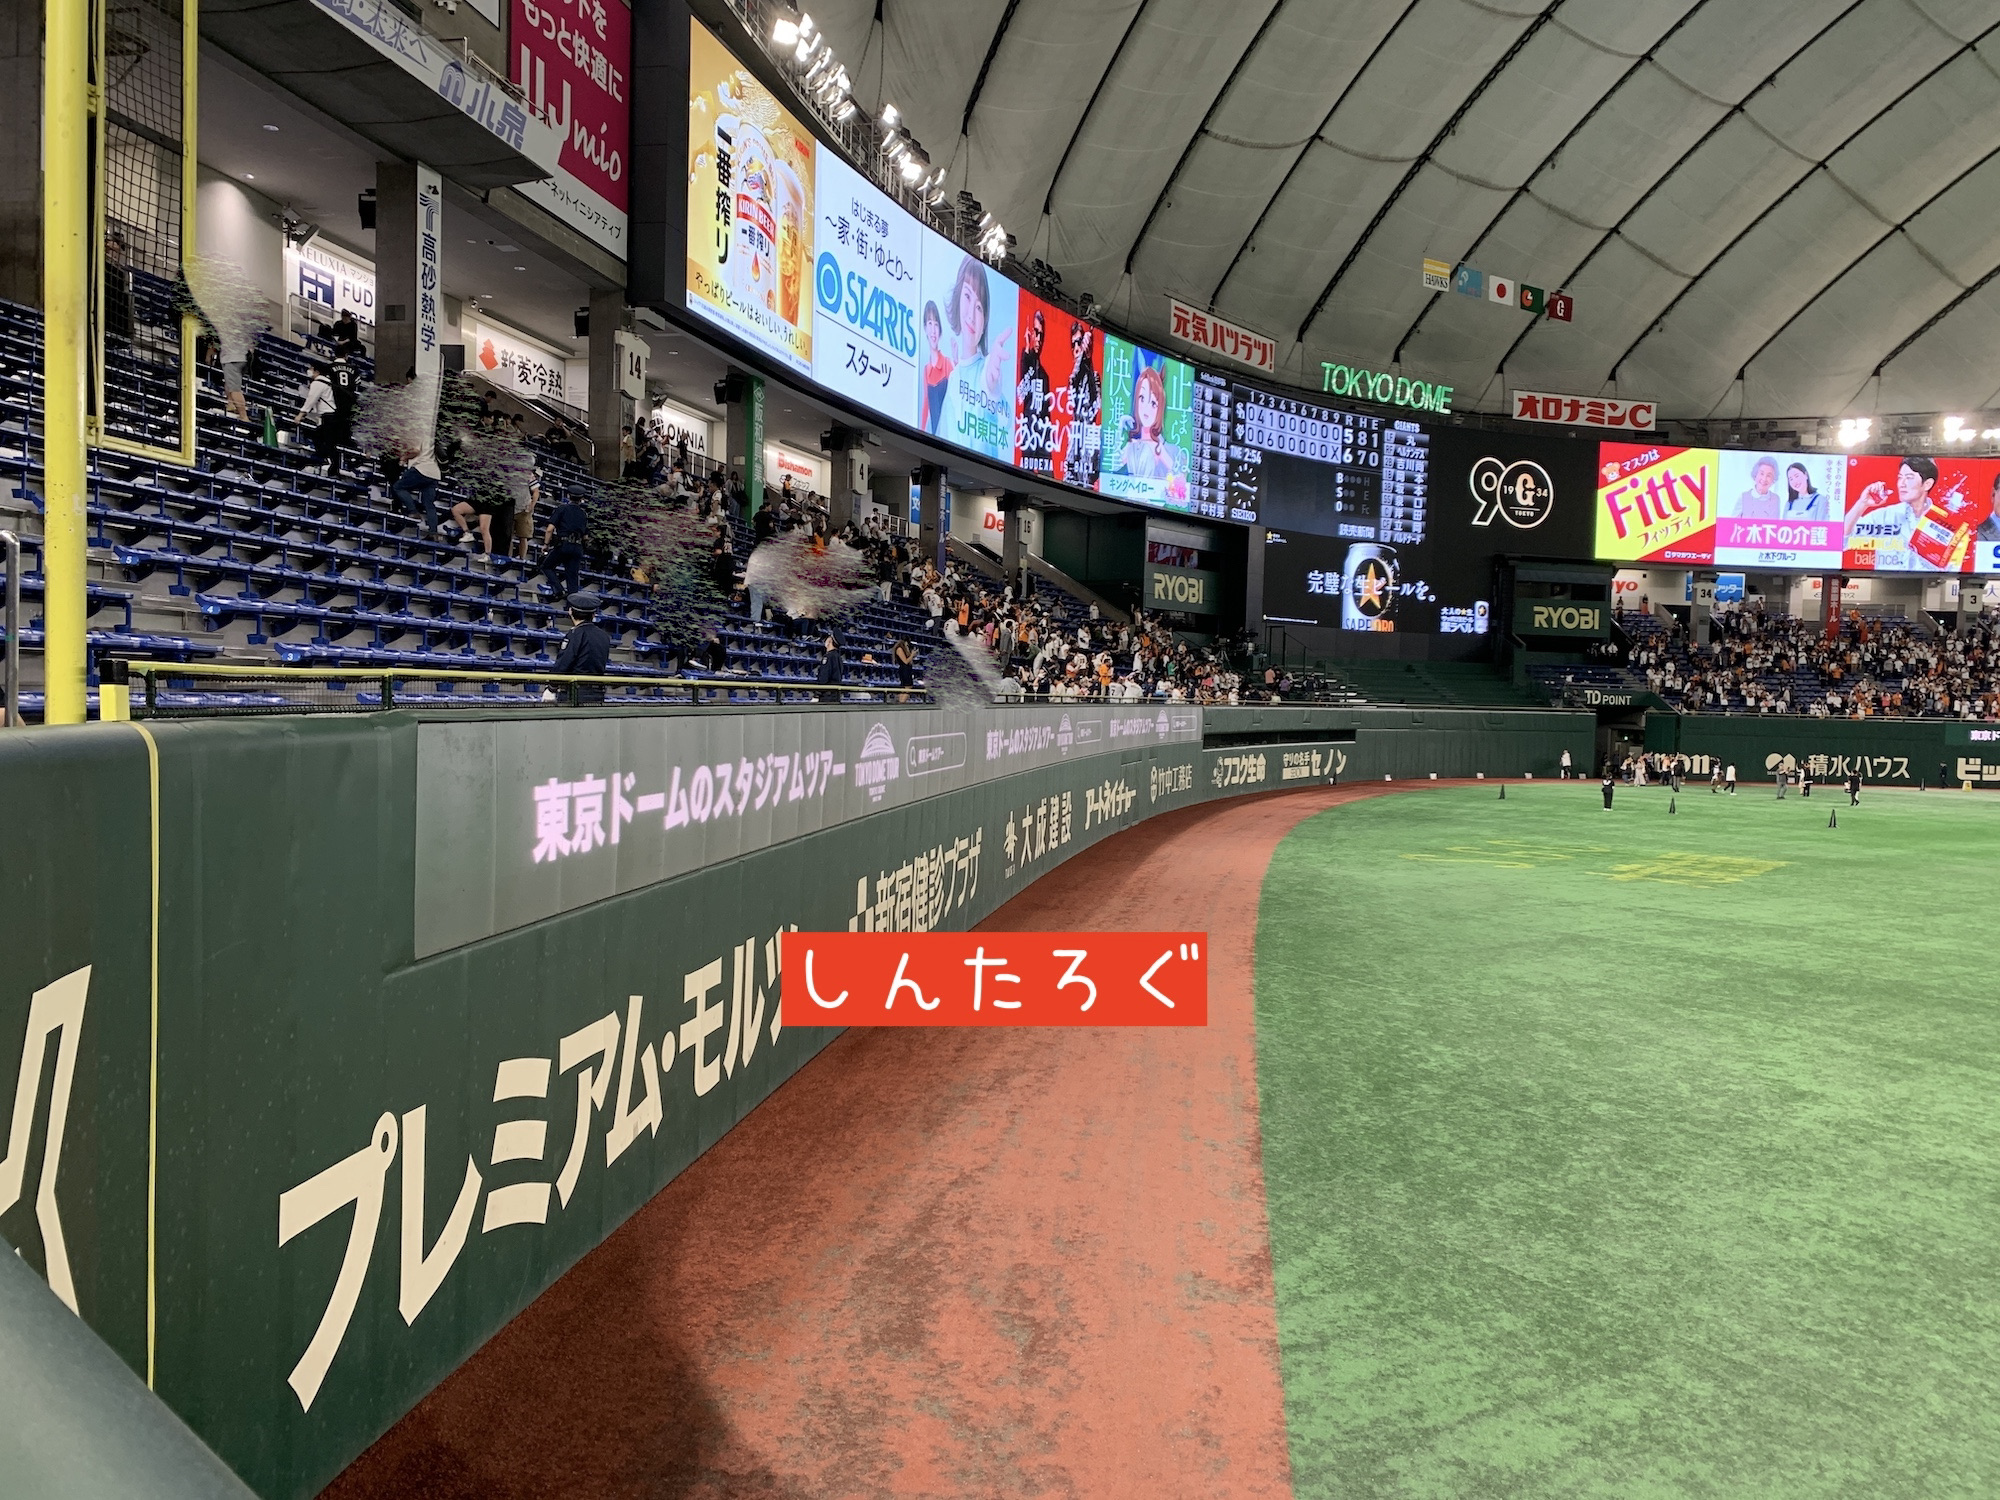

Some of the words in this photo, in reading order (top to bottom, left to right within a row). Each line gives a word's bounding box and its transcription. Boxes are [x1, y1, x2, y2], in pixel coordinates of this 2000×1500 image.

[563, 0, 608, 41] トを
[518, 0, 622, 103] もっと快適に
[466, 82, 528, 150] 小泉
[536, 179, 622, 239] ーネットイニシアティブ
[716, 125, 732, 265] 一番搾り
[739, 201, 758, 220] KIRIN
[851, 196, 890, 238] はじまる夢
[741, 225, 770, 257] 一番搾り
[421, 232, 437, 352] 高砂熱学
[1425, 273, 1448, 289] HAWKS
[695, 271, 808, 356] やっぱりビールはおいしい、うれしい。
[844, 270, 917, 358] STARTS
[339, 371, 349, 386] 8
[501, 349, 563, 398] 新菱冷熱
[629, 352, 641, 380] 14
[845, 342, 892, 388] スターツ
[1320, 361, 1394, 404] TOKYO
[1396, 376, 1454, 415] DOME
[1102, 345, 1131, 474] 快進撃
[1167, 363, 1193, 473] 止まらぬ
[1517, 394, 1653, 429] オロナミンC
[957, 411, 1009, 450] JR東日本
[1015, 413, 1101, 457] あぶない刑事
[1394, 420, 1420, 433] GIANTS
[778, 451, 813, 477] Bishamon
[860, 463, 864, 480] 4
[1244, 448, 1262, 465] 2:54
[1396, 458, 1425, 473] 吉川尚
[1620, 448, 1661, 471] マスクは
[1109, 477, 1155, 494] キングヘイロー
[1336, 472, 1344, 484] B
[1336, 486, 1343, 498] S
[1503, 485, 1514, 495] 19
[1536, 488, 1548, 498] 34
[1515, 473, 1536, 506] G
[1231, 507, 1257, 522] SEIKO
[1605, 465, 1708, 540] Fitty
[1636, 516, 1693, 549] フィッティ
[1746, 524, 1829, 546] 木下の介護
[1856, 523, 1902, 536] アリナミン
[1764, 552, 1797, 561] 木下グループ
[1153, 572, 1204, 605] RYOBI
[1307, 569, 1437, 602] 完璧な生ビールを。
[1700, 588, 1712, 598] 34
[1970, 595, 1977, 604] 3
[1440, 622, 1474, 633] 黒ラベル
[1533, 605, 1600, 630] RYOBI
[1584, 689, 1601, 705] TD
[1602, 695, 1632, 706] POINT
[986, 725, 1055, 761] 東京ドームのスタジアムツアー
[1223, 753, 1267, 787] フコク生命
[1311, 749, 1347, 777] セノン
[1808, 754, 1910, 779] 積水ハウス
[1158, 763, 1193, 797] 竹中工務店
[532, 748, 846, 864] 東京ドームのスタジアムツアー
[1084, 778, 1137, 831] アートネイチャー
[1020, 791, 1073, 868] 大成建設
[875, 827, 982, 932] 新宿健診プラザ
